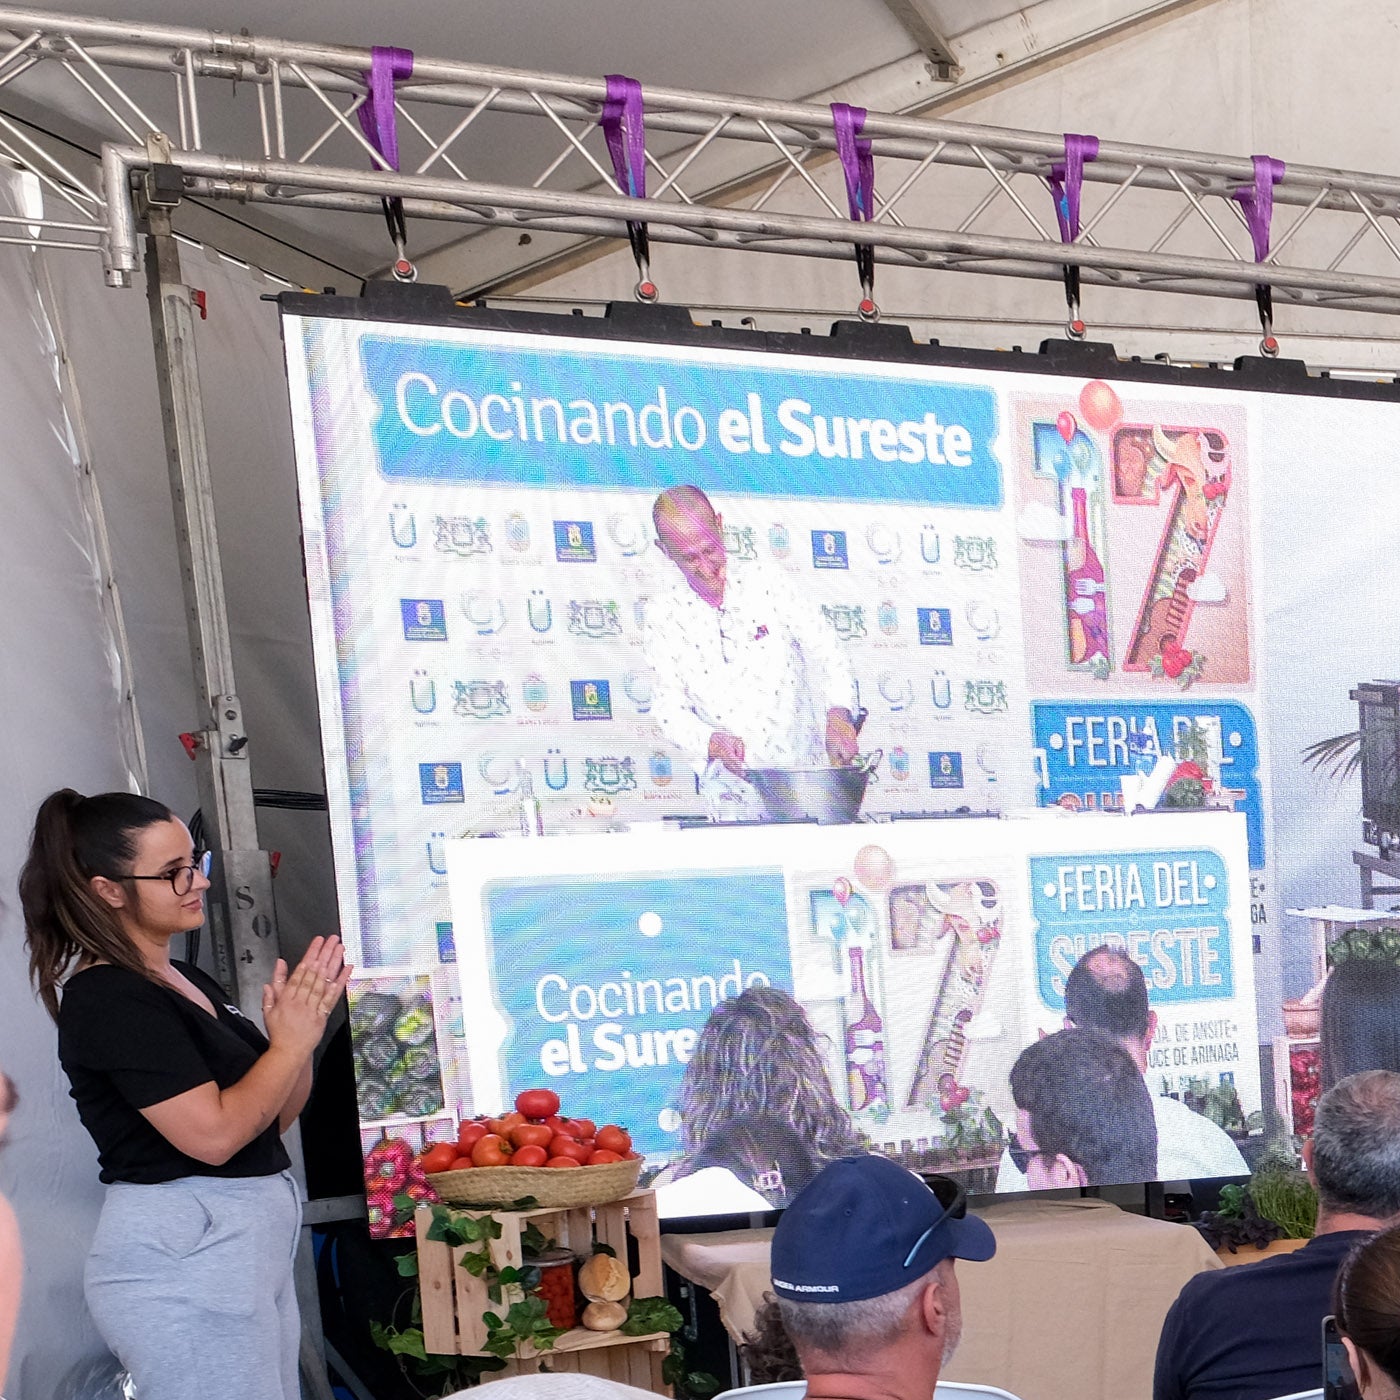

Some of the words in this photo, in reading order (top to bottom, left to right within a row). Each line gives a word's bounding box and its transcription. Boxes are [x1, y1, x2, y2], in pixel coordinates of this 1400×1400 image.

[395, 371, 704, 451] Cocinando
[718, 392, 770, 454] el
[776, 399, 973, 468] Sureste
[1058, 862, 1146, 913] FERIA
[1153, 860, 1209, 908] DEL
[1050, 926, 1222, 997] SESTE
[541, 1025, 587, 1077] el
[592, 1022, 695, 1073] Sure
[1149, 1048, 1170, 1068] UCE
[1174, 1047, 1189, 1066] DE
[1191, 1043, 1239, 1065] ARINAGA
[795, 1284, 839, 1293] ARMOUR
